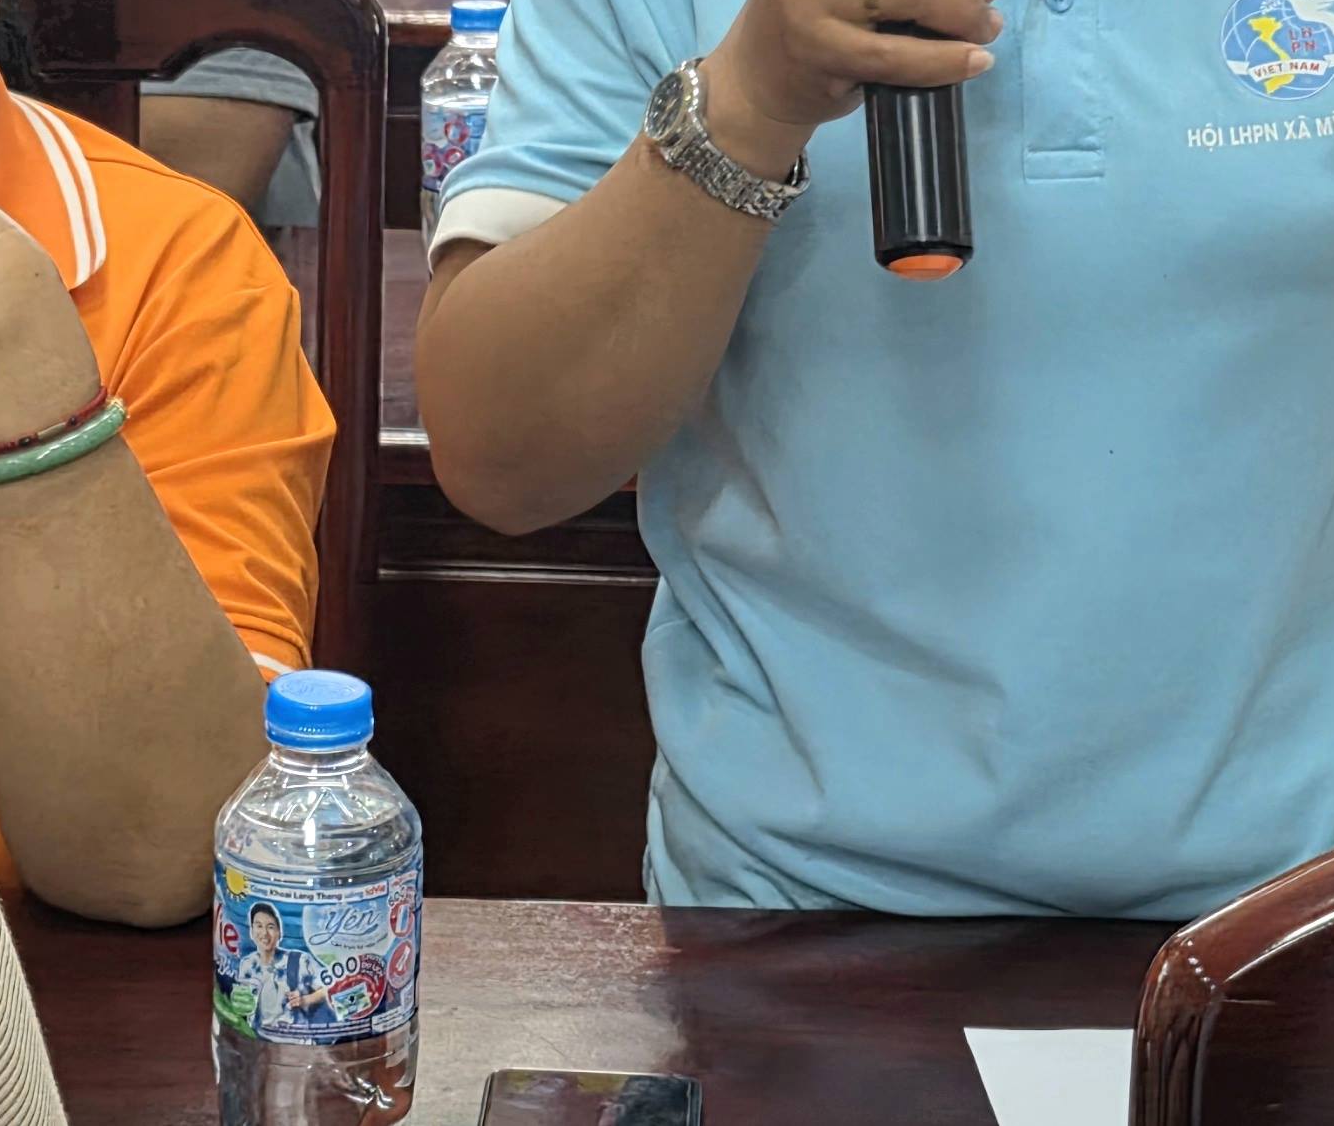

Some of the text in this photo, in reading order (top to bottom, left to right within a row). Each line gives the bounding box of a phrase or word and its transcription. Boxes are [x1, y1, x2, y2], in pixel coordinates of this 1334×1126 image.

[1289, 61, 1320, 72] NAM
[1187, 123, 1223, 152] HỘI
[1230, 123, 1279, 146] LHPN
[1284, 115, 1312, 140] XÃ
[320, 956, 358, 986] 600
